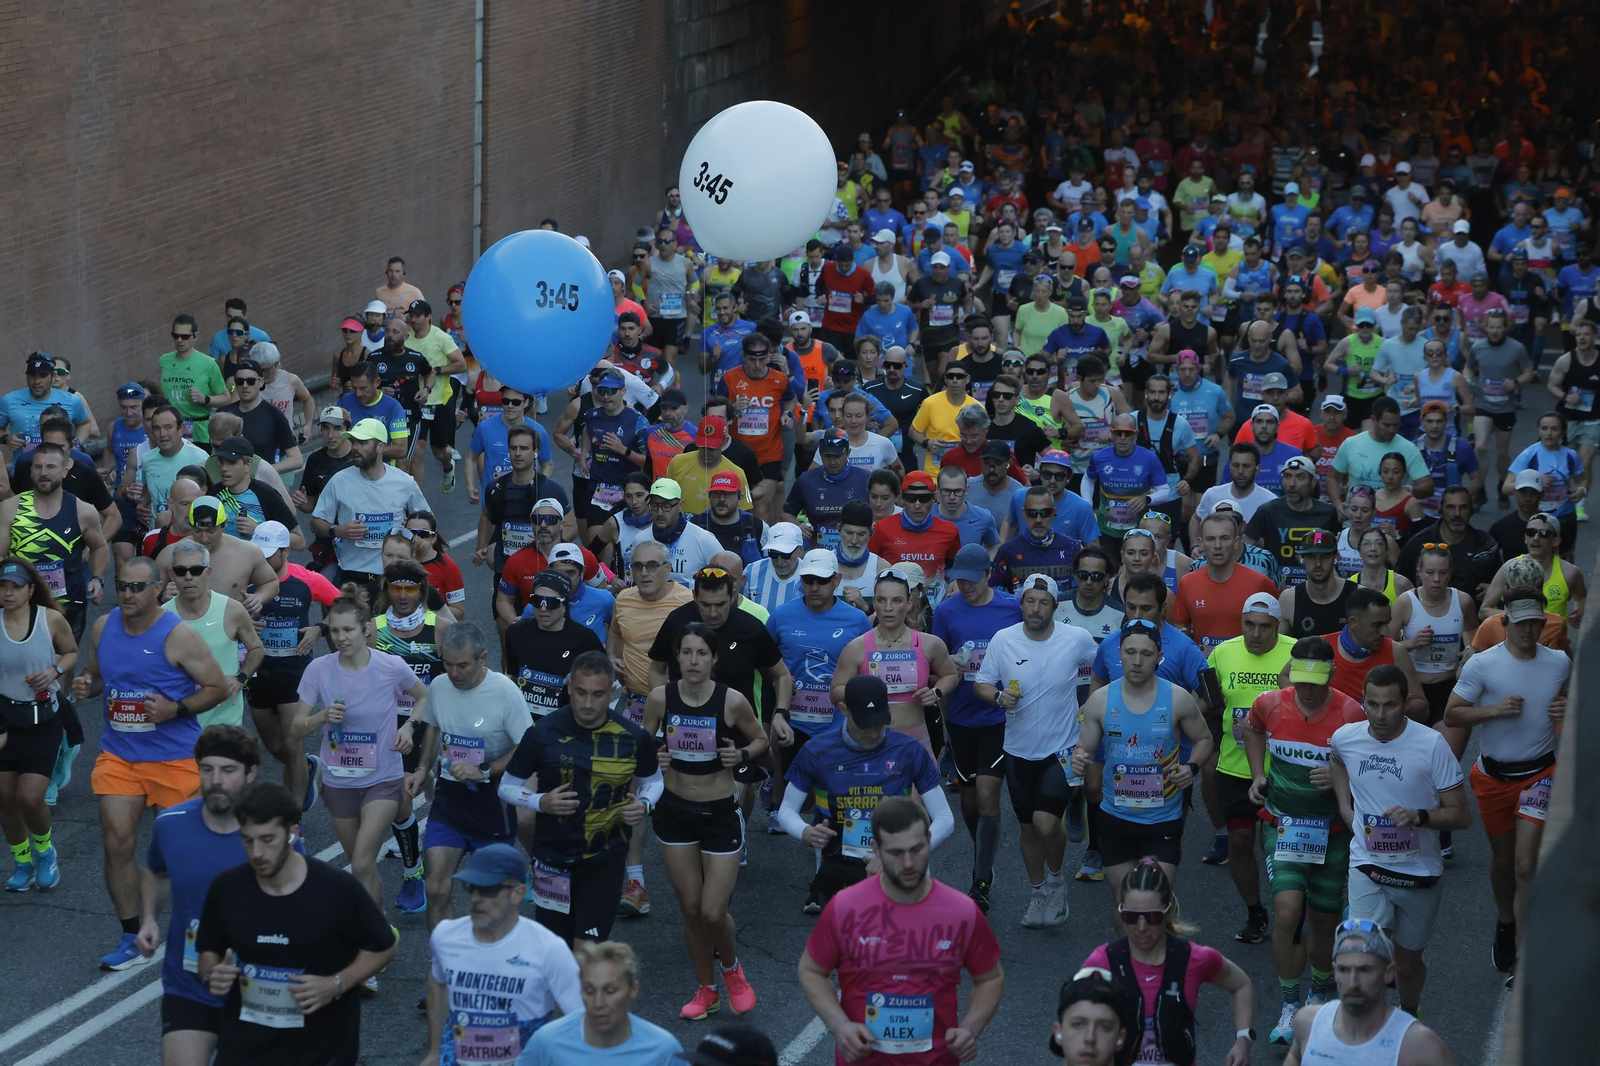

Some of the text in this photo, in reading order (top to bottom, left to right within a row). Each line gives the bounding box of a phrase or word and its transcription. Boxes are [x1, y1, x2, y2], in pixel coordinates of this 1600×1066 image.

[694, 161, 734, 205] 3:45
[536, 281, 579, 312] 3:45
[163, 377, 196, 386] MARATHON
[754, 421, 767, 429] LUIS
[713, 477, 731, 485] HOKA
[363, 532, 385, 540] CHRIS
[900, 553, 935, 561] SEVILLA
[269, 621, 293, 629] ZURICH
[260, 638, 292, 648] CARLOS
[1430, 653, 1443, 662] LIZ
[533, 673, 560, 684] ZURICH
[885, 673, 902, 683] EVA
[532, 685, 546, 694] 4254
[806, 683, 831, 691] ZURICH
[119, 691, 147, 699] ZURICH
[789, 704, 834, 714] JORGE ARAUJO
[113, 713, 147, 723] ASHRAF
[682, 718, 710, 727] ZURICH
[343, 734, 371, 742] ZURICH
[453, 738, 479, 747] ZURICH
[678, 739, 705, 751] LUCÍA
[340, 756, 364, 766] NENE
[1369, 753, 1397, 767] French
[1129, 766, 1157, 774] ZURICH
[1358, 760, 1404, 782] Montagnard
[848, 786, 885, 796] VII TRAIL
[1114, 788, 1164, 799] WARRIORS 284
[836, 796, 880, 809] SIERRA
[1295, 817, 1324, 827] ZURICH
[1294, 831, 1310, 840] 4435
[1381, 832, 1398, 840] 9507
[1276, 841, 1326, 854] TEHEL TIBOR
[1372, 840, 1411, 851] JEREMY
[540, 888, 570, 903] RUNNER
[841, 919, 970, 969] VALENCIA
[455, 971, 526, 994] MONTGERON
[889, 998, 927, 1007] ZURICH
[472, 1017, 510, 1026] ZURICH
[889, 1015, 910, 1024] 5784
[883, 1027, 915, 1039] ALEX
[461, 1046, 512, 1059] PATRICK
